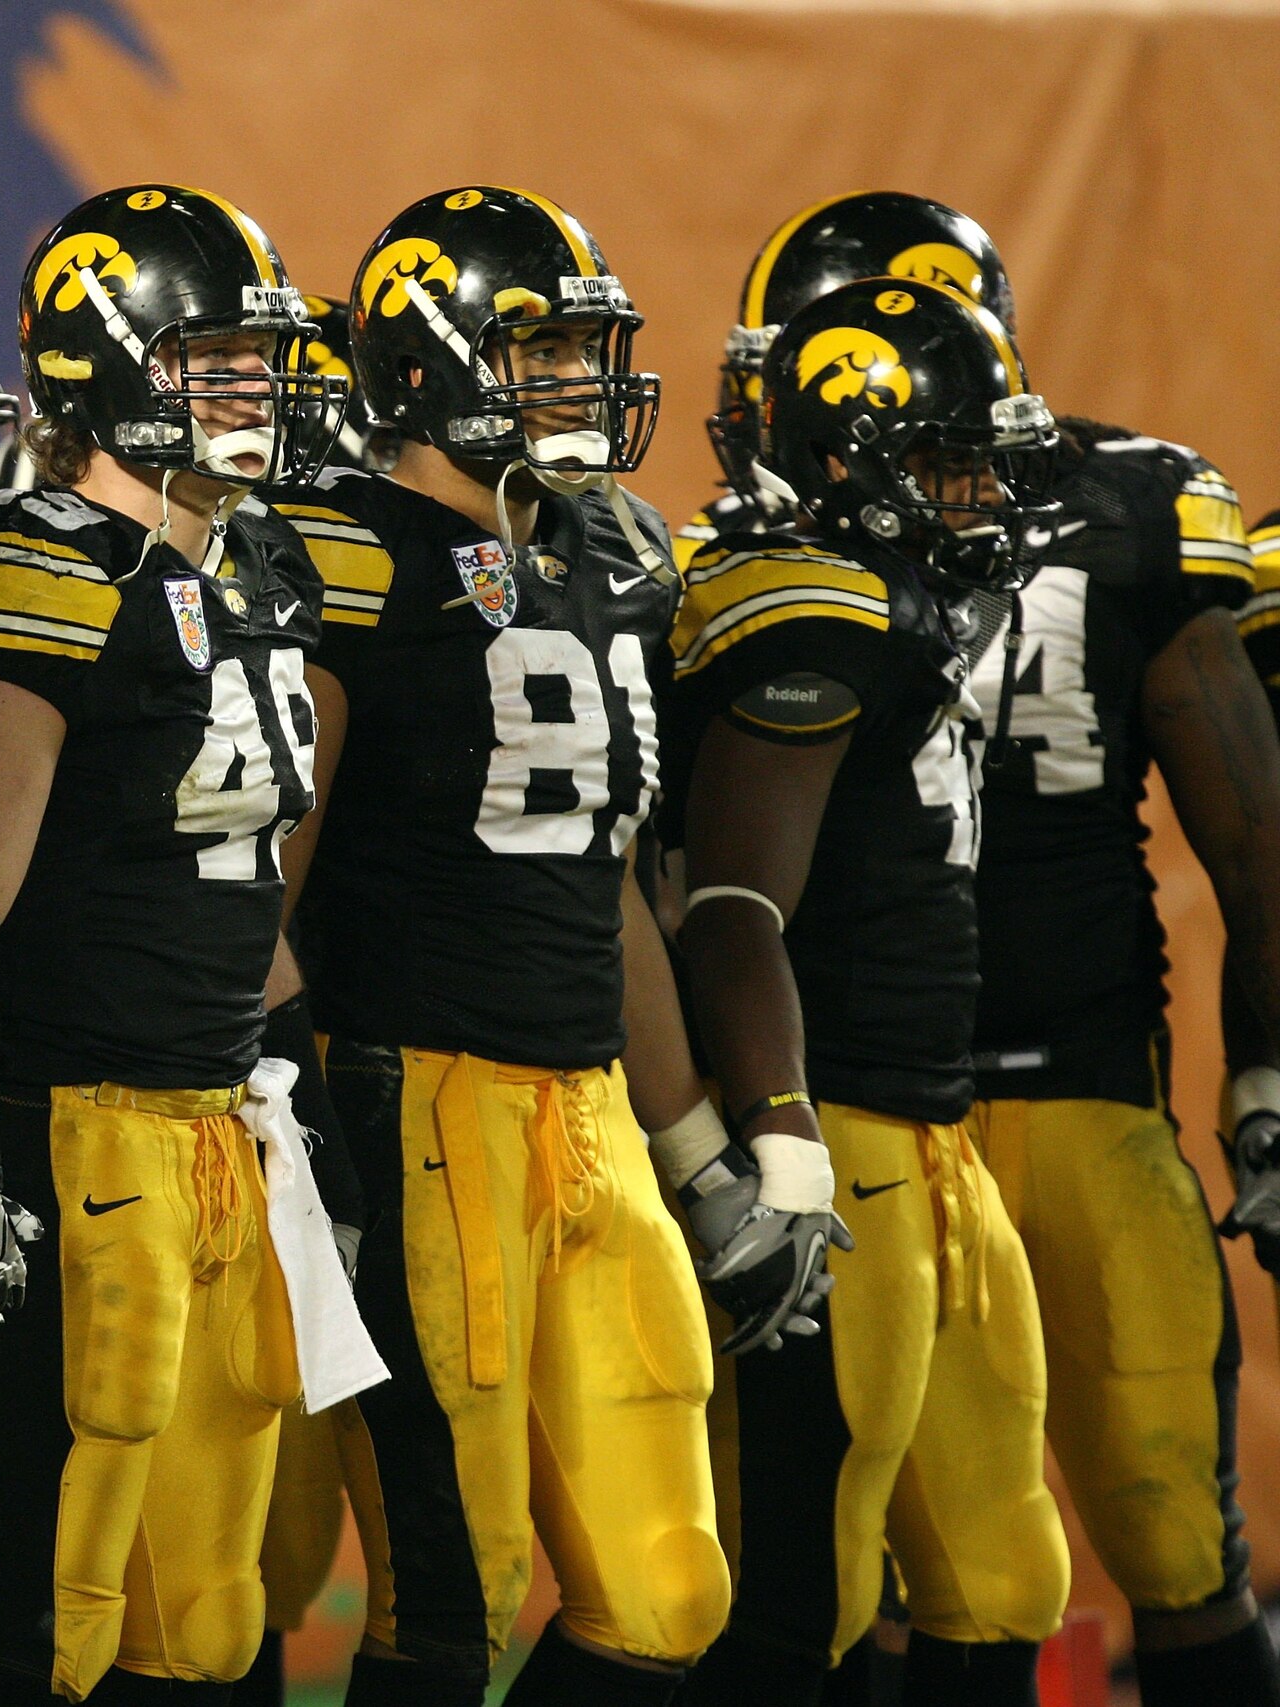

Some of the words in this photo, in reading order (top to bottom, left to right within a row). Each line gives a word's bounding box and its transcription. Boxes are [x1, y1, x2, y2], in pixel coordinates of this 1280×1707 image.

[583, 279, 608, 294] IOW
[265, 292, 288, 307] IOW
[452, 545, 503, 569] FedEx
[165, 583, 199, 604] FedEx
[766, 686, 818, 704] Riddell
[473, 628, 661, 857] 81
